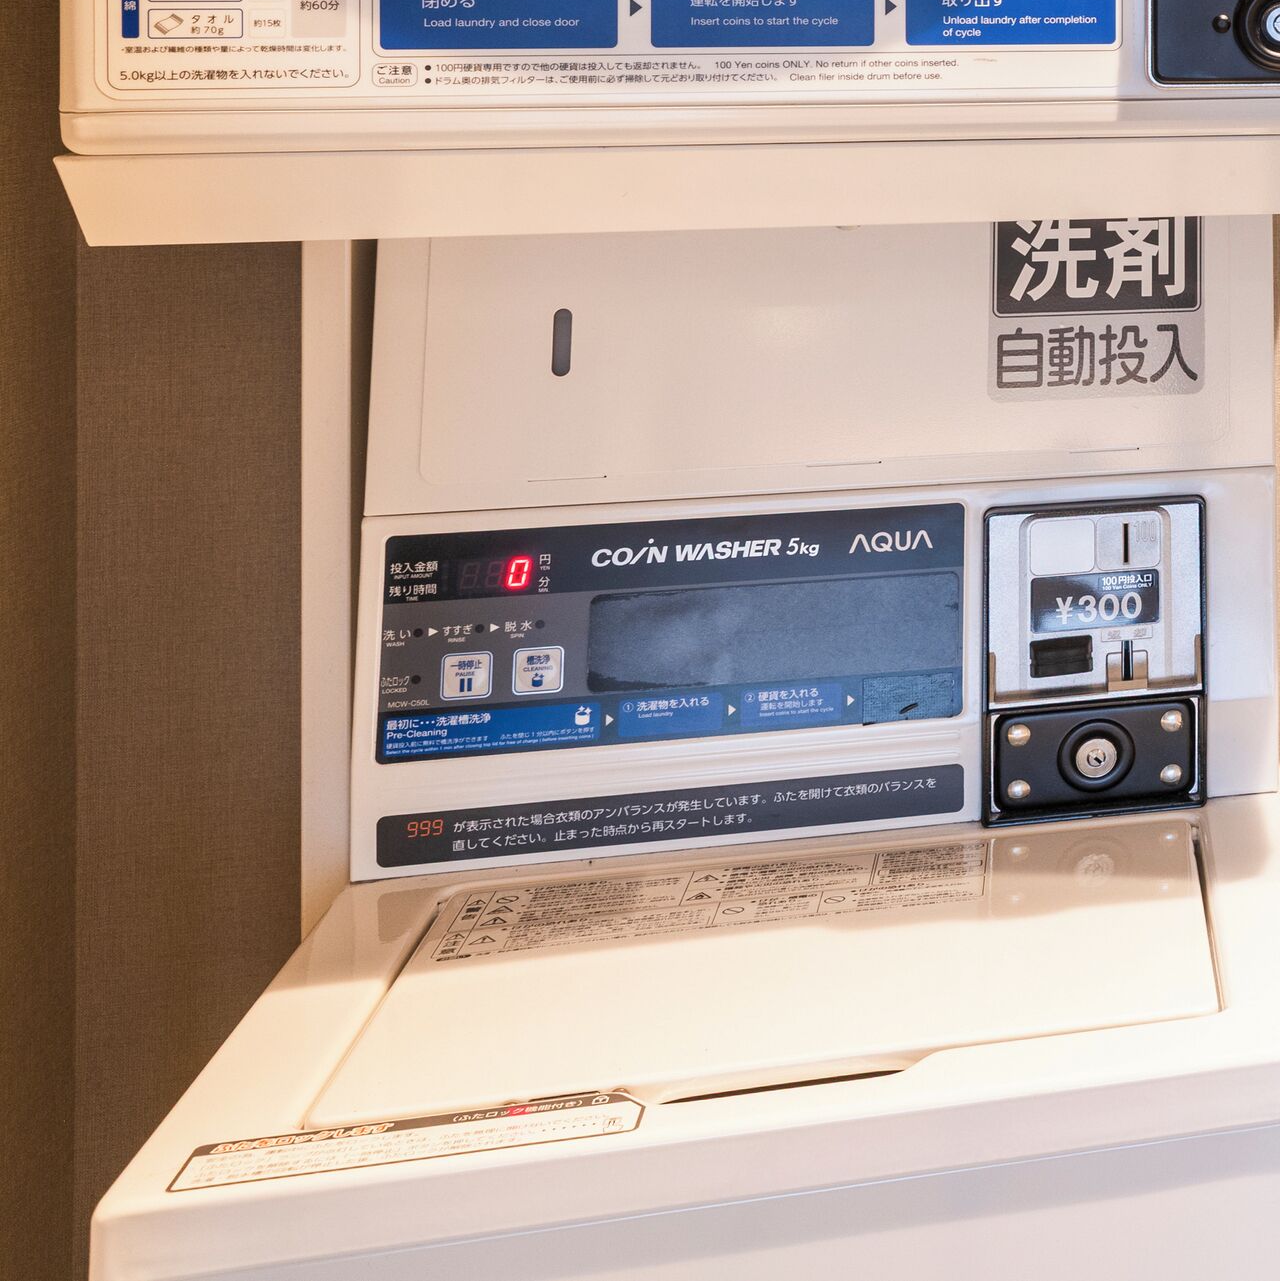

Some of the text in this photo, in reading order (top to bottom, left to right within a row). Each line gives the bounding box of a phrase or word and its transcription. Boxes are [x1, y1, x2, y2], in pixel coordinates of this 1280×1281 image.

[300, 0, 340, 11] 約60分
[424, 17, 580, 30] Load laundry and close door
[690, 16, 839, 29] Insert coins to start the cycle
[943, 14, 1097, 28] Unload laundry after completion
[943, 27, 982, 38] of cycle
[1009, 216, 1186, 302] 洗剤
[997, 323, 1199, 389] 自動投入
[675, 538, 781, 563] WASHER
[848, 529, 934, 555] AQUA
[507, 558, 530, 588] 0
[1055, 591, 1143, 626] ¥300
[386, 727, 448, 741] Pre-Cleaning
[406, 818, 445, 839] 999
